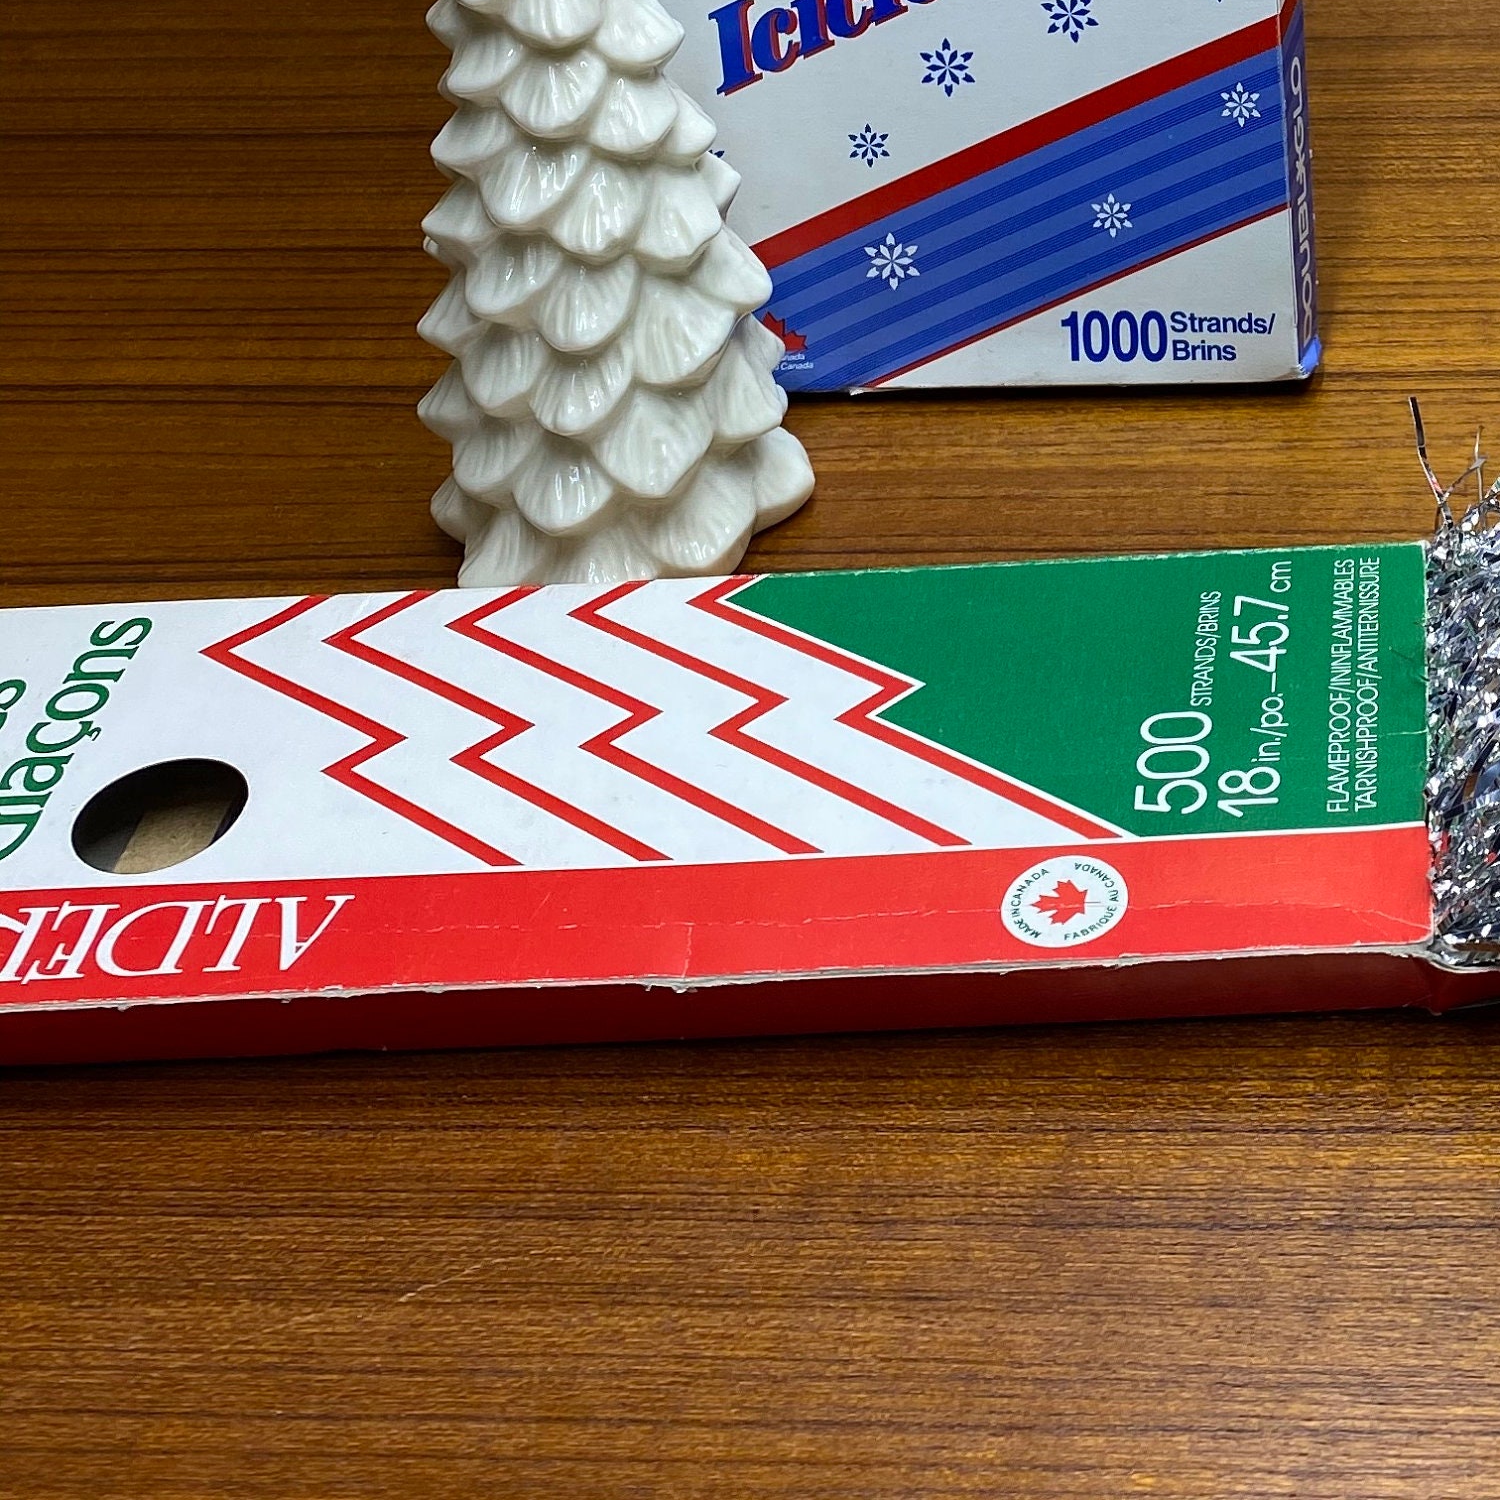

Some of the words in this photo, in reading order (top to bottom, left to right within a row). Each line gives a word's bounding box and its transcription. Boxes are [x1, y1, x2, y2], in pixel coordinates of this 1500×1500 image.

[1060, 309, 1169, 363] 1000
[1170, 311, 1276, 336] Strands/
[1171, 338, 1237, 362] Brins
[1134, 710, 1213, 814] 500
[1190, 590, 1222, 707] STRANDS/BRINS
[1217, 766, 1281, 818] 18
[1269, 560, 1293, 594] cm
[1326, 558, 1355, 813] FLAMEPROOF/ININFLAMMABLES
[1354, 556, 1382, 812] TARNISHPROOF/ANTITERNISSURE
[1011, 868, 1050, 907] CANADA
[1074, 862, 1115, 888] CANADA
[1109, 889, 1120, 903] AU
[1013, 916, 1042, 939] MADE
[1064, 906, 1118, 941] FABRIQUE
